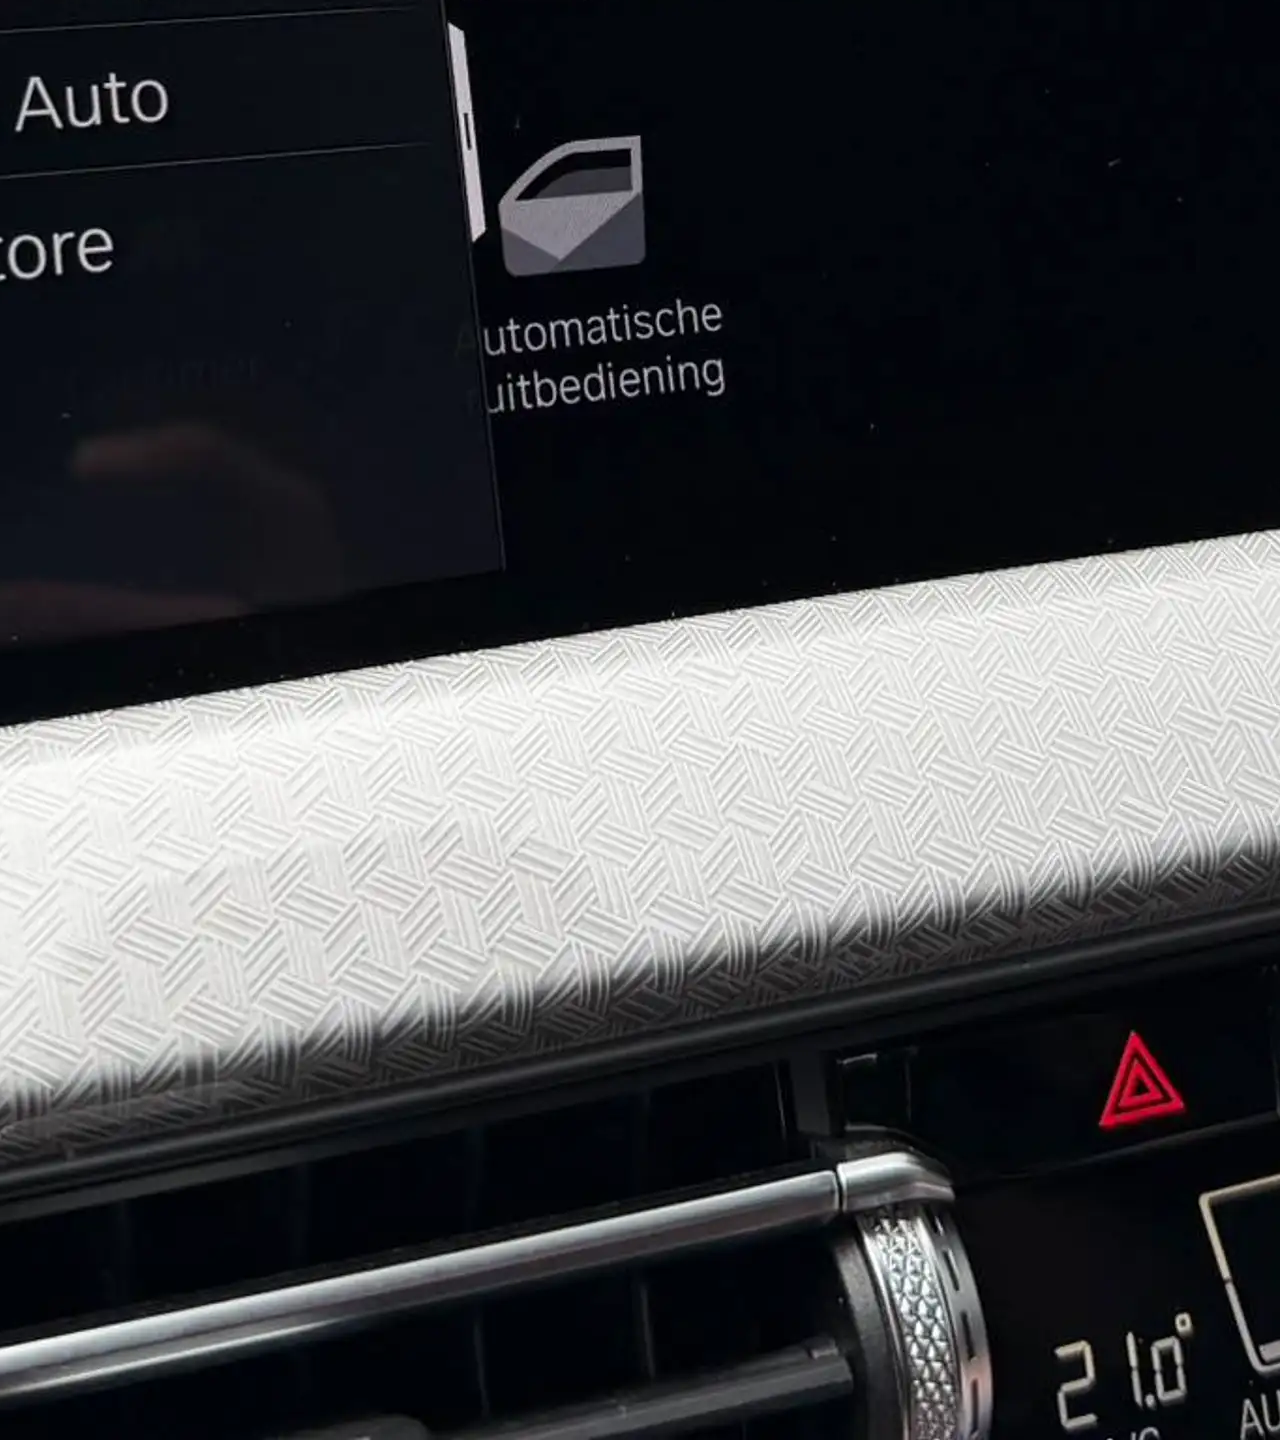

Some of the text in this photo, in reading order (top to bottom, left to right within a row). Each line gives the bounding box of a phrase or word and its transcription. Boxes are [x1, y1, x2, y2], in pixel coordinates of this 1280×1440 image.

[16, 73, 169, 133] Auto
[483, 298, 722, 357] utomatische
[487, 356, 725, 414] uitbediening
